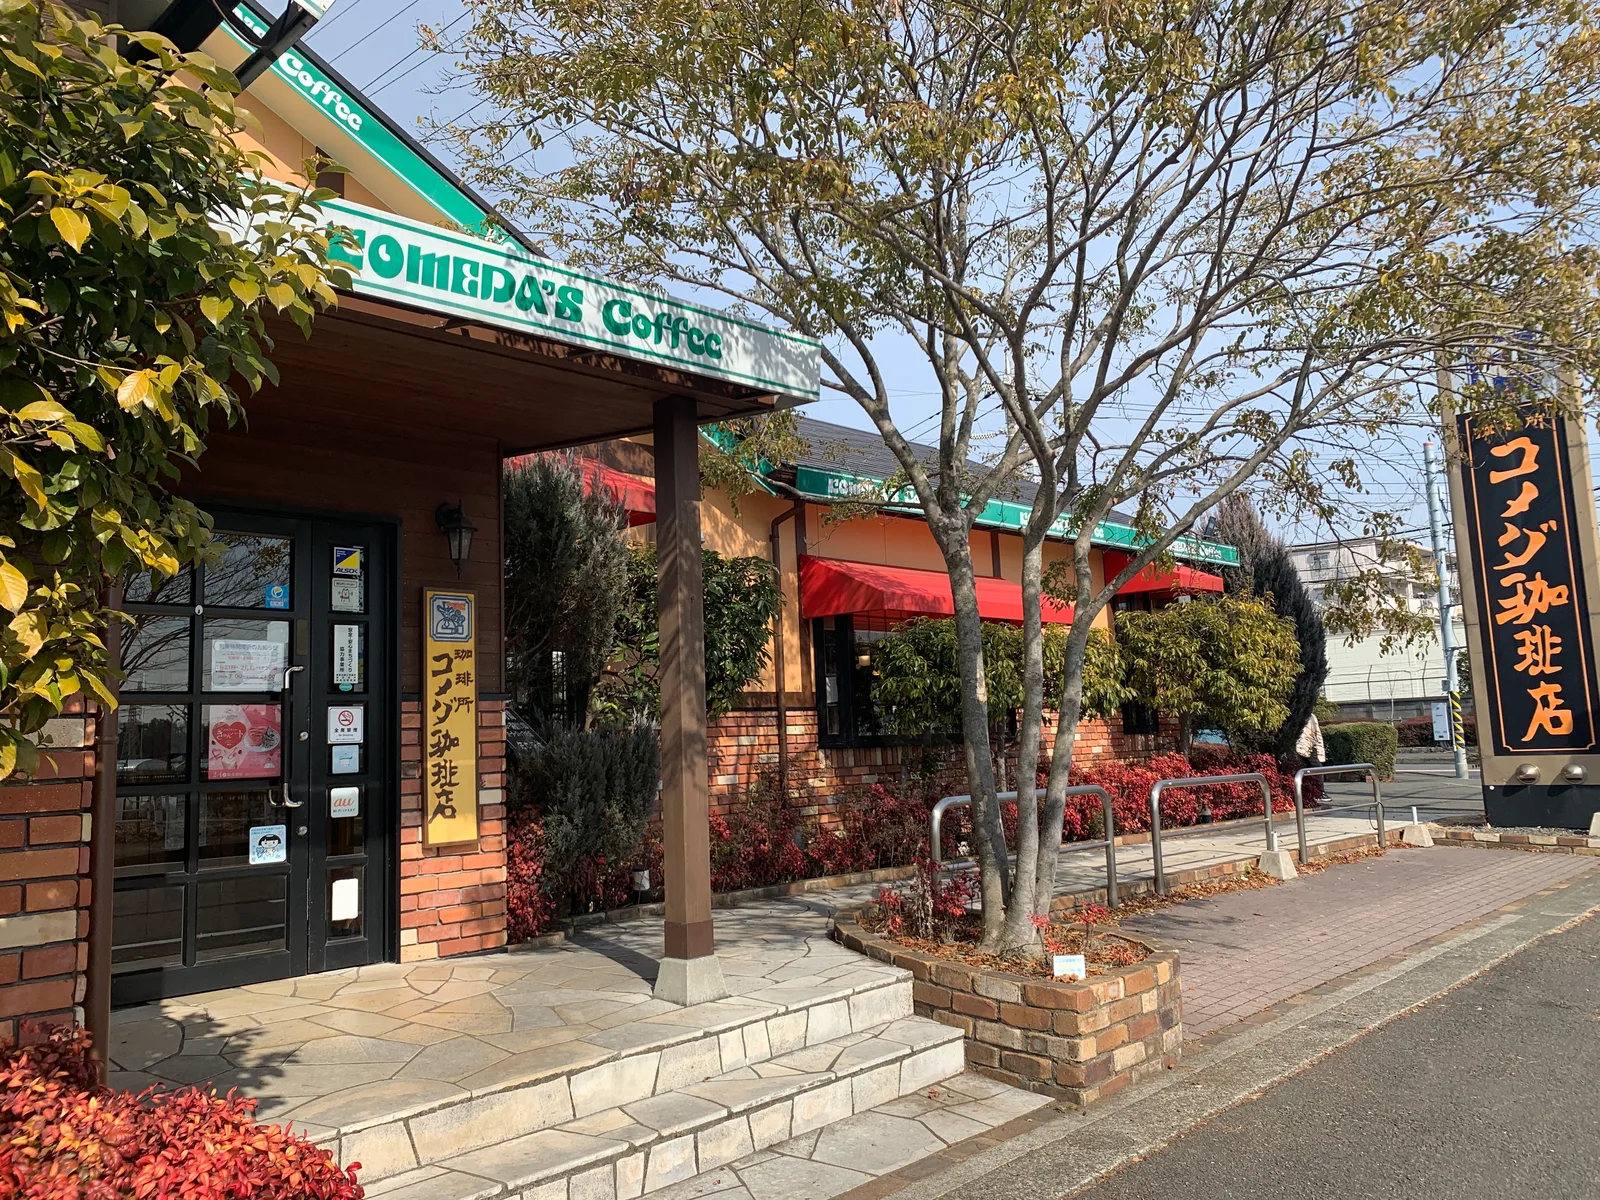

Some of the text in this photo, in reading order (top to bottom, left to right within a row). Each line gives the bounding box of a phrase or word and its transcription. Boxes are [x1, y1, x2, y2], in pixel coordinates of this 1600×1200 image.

[278, 52, 363, 131] Coffee
[602, 299, 722, 360] Coffee
[1489, 436, 1573, 742] コメダ珈琲店
[454, 648, 474, 713] 珈琲所
[428, 653, 460, 824] コメダ珈琲店
[333, 798, 355, 808] au
